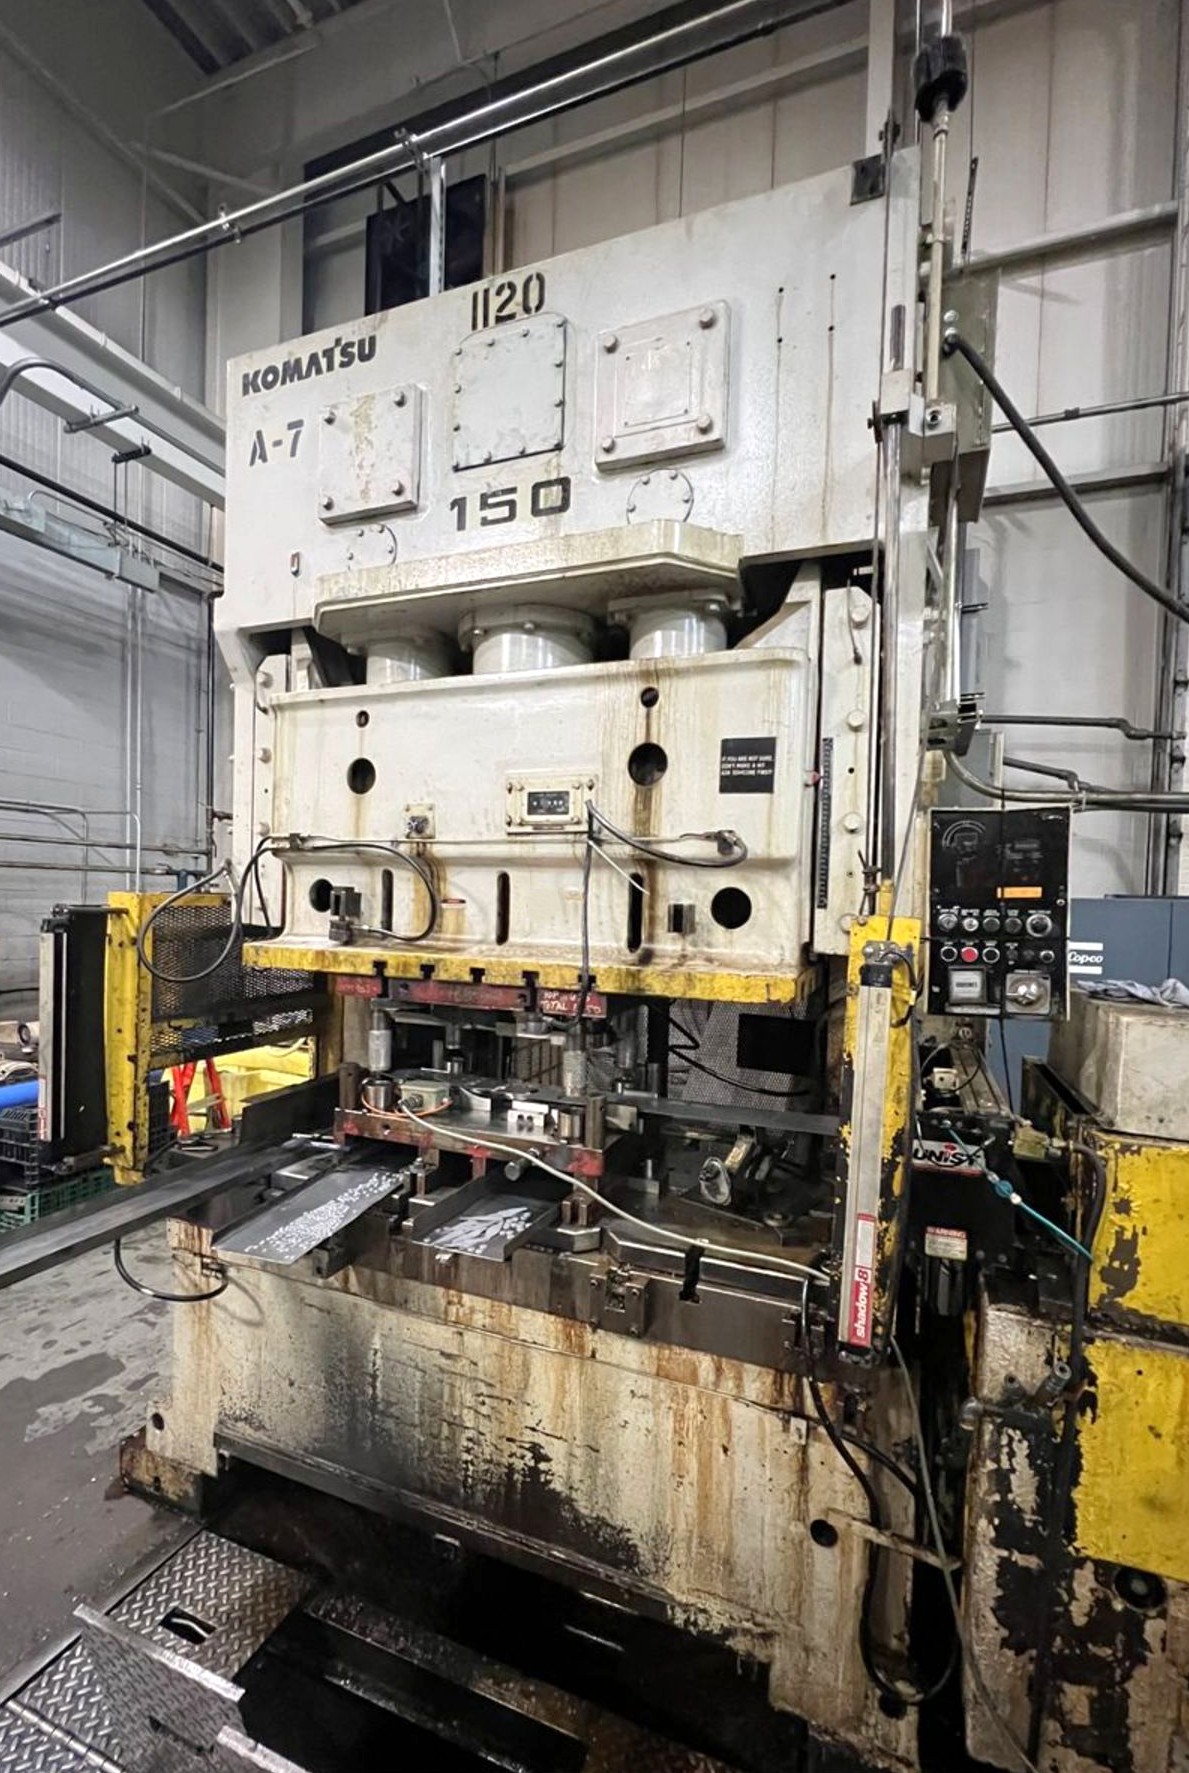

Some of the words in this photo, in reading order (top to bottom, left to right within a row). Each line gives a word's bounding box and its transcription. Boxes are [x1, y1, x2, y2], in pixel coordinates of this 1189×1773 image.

[471, 272, 546, 331] 1120
[242, 335, 377, 397] KOMATSU
[249, 419, 304, 467] A-7
[450, 476, 572, 532] 150
[1068, 951, 1104, 964] Copco
[854, 1283, 869, 1338] shadow
